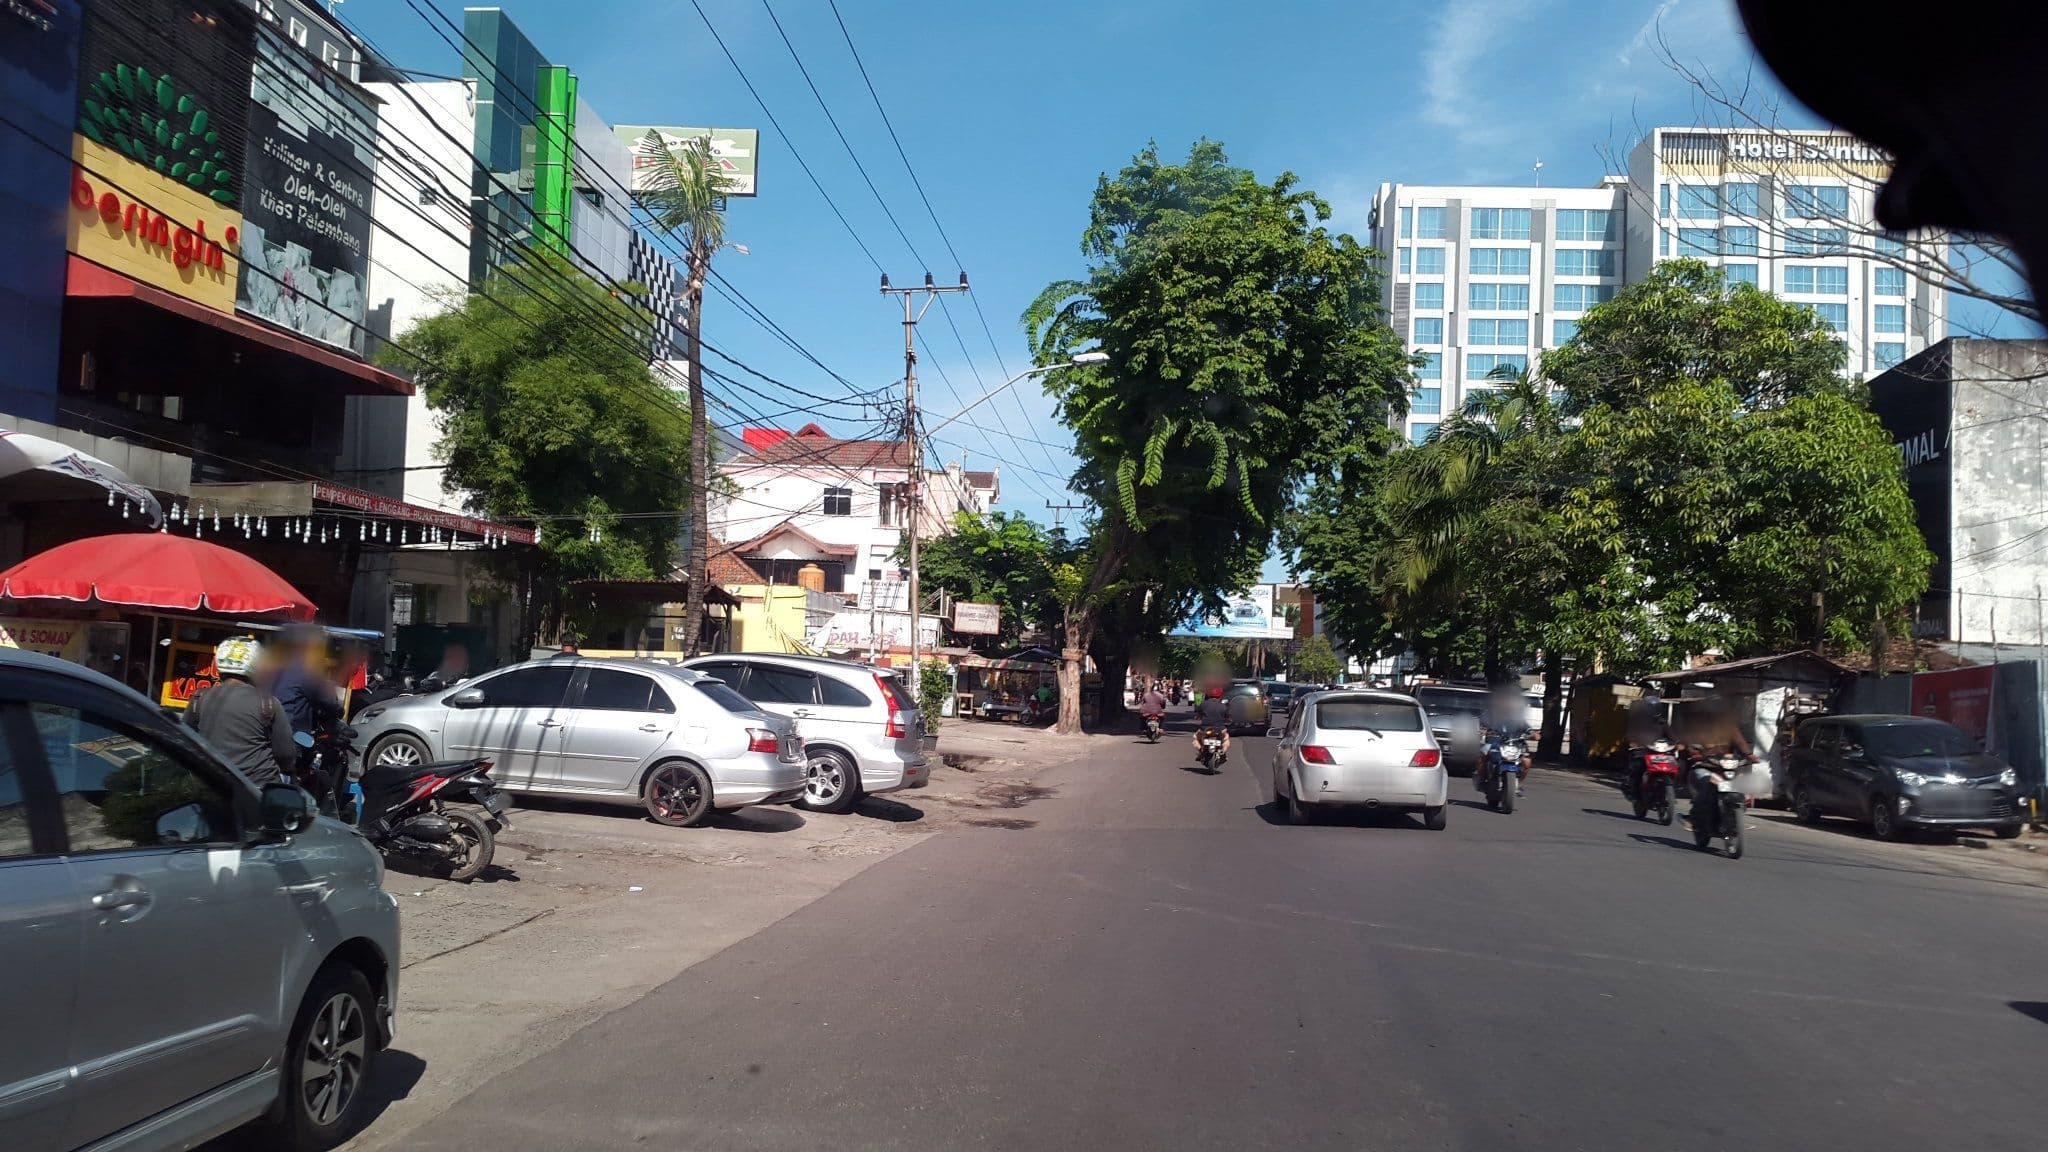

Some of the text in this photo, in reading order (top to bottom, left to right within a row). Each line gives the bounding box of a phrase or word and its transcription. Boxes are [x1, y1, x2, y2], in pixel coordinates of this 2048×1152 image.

[263, 136, 363, 208] Kuliner & Sentra
[1731, 139, 1795, 158] Hotel
[71, 166, 223, 270] beringin
[260, 188, 360, 257] Khas Palembang
[284, 174, 346, 221] Oleh-Oleh
[20, 630, 27, 643] &
[30, 629, 73, 646] SIOMAY
